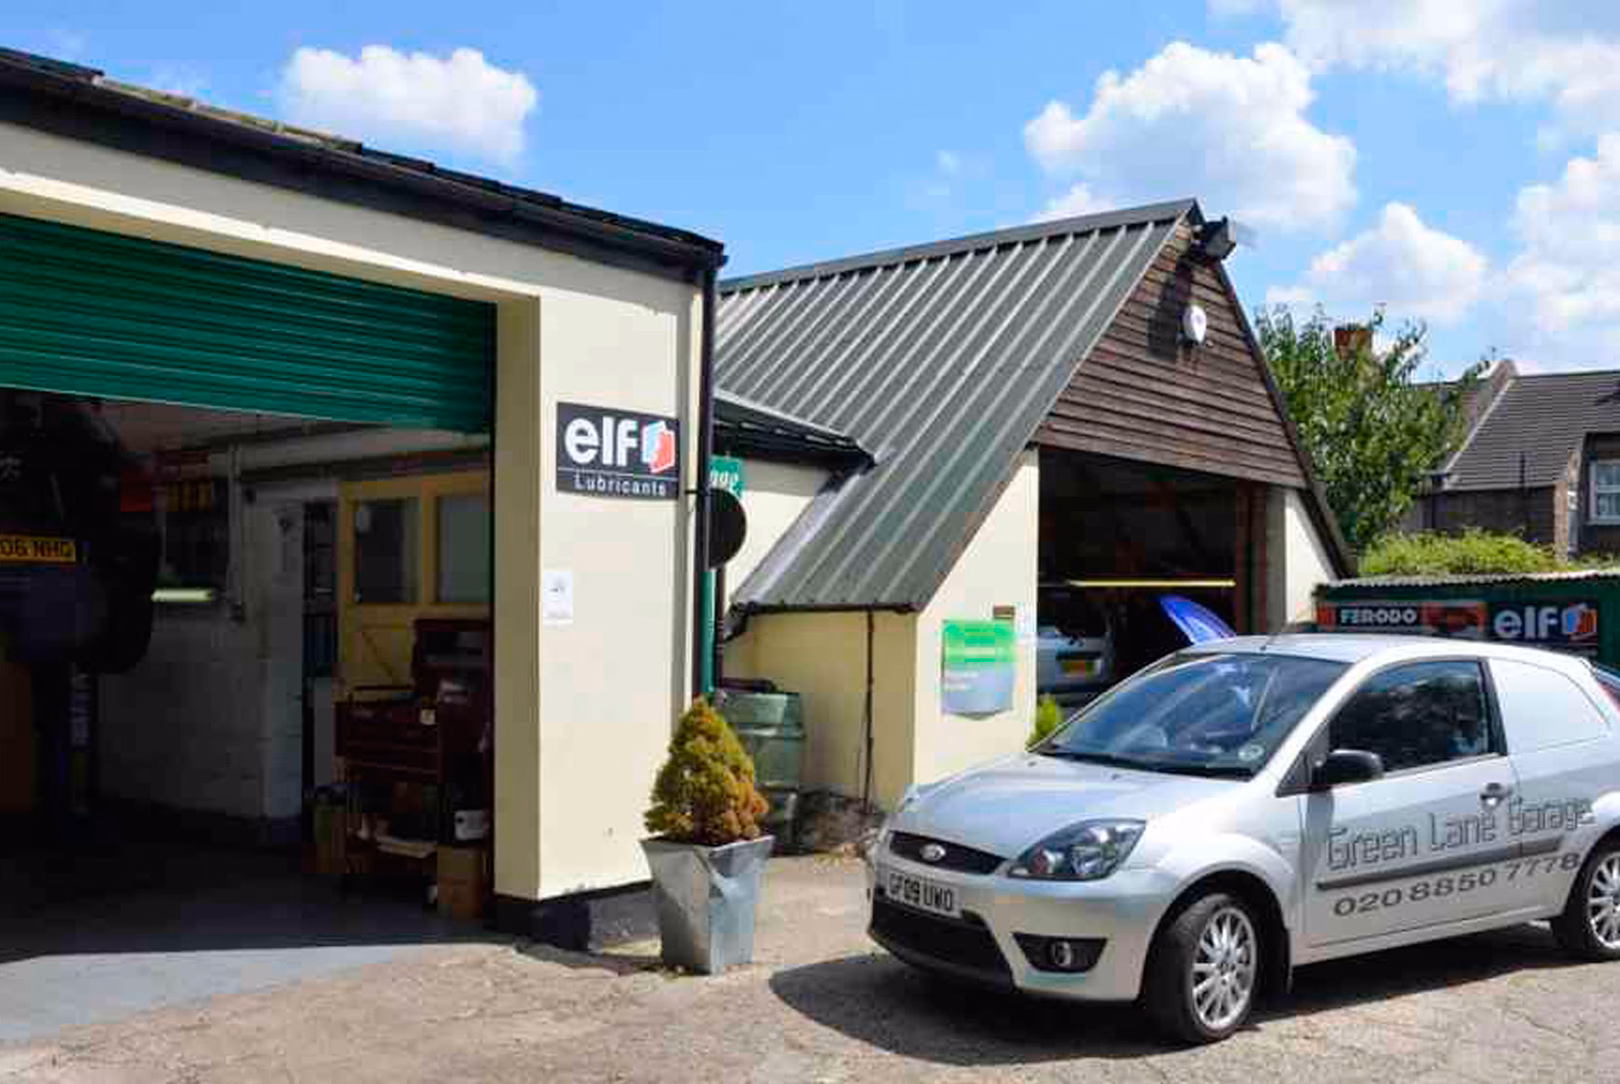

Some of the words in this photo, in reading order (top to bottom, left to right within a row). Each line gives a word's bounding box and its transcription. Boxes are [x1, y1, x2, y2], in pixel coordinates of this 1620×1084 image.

[565, 416, 638, 467] elf
[574, 474, 667, 496] Lubricants
[1340, 608, 1418, 625] FERODO
[1495, 606, 1559, 639] elf
[1327, 823, 1418, 870] Green
[1429, 811, 1497, 851] Lane
[1507, 797, 1596, 836] Garage
[1333, 888, 1402, 916] 020
[1408, 868, 1497, 902] 8850
[1504, 852, 1580, 881] 7778
